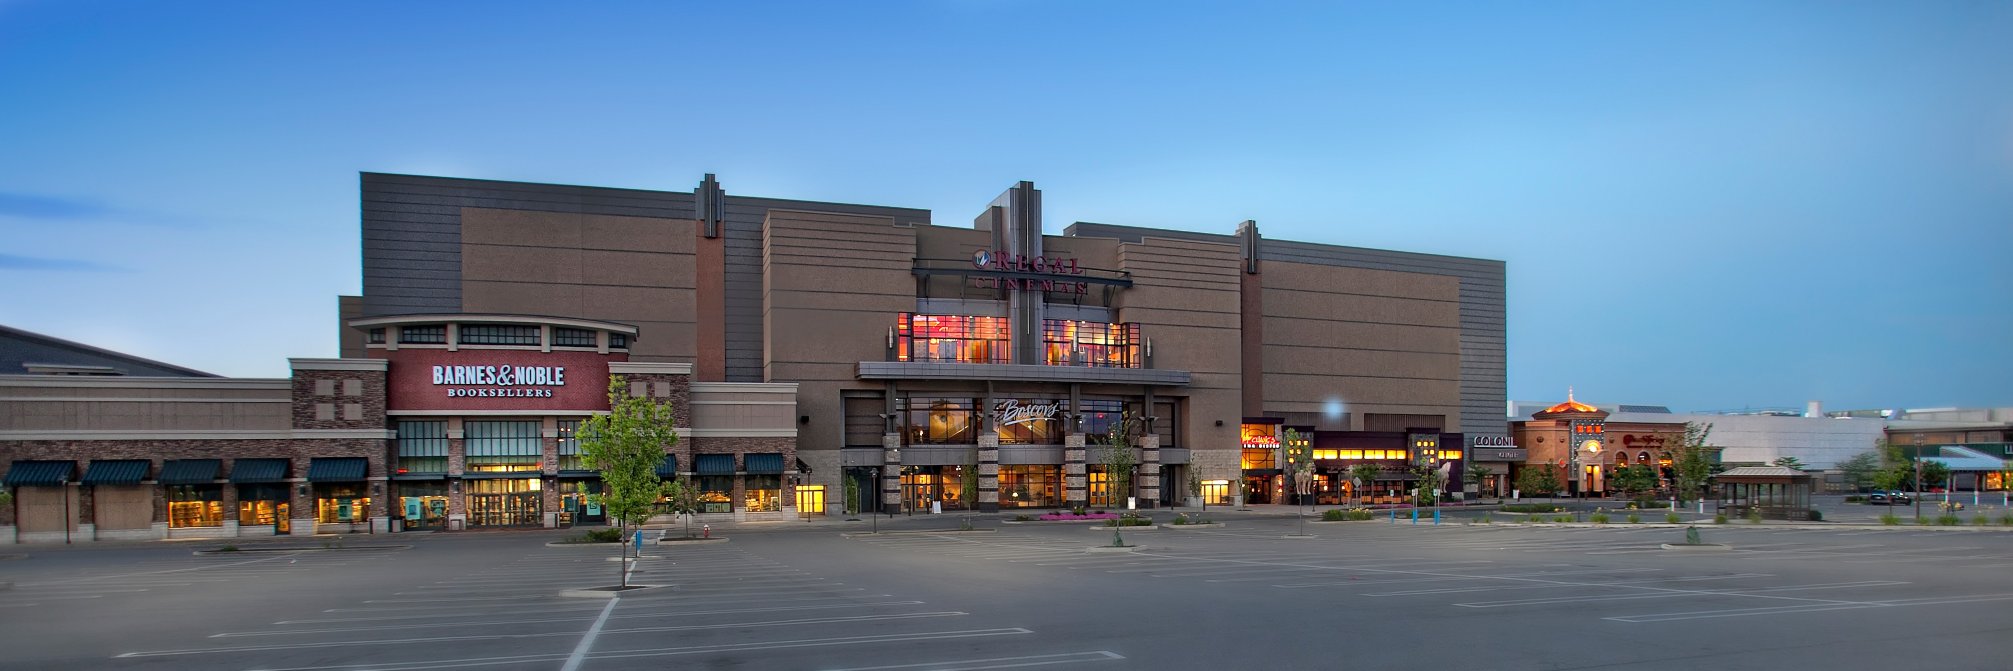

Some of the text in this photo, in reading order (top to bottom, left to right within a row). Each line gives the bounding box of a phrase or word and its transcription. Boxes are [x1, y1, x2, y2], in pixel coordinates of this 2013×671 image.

[994, 250, 1083, 274] REGAL
[975, 277, 1086, 294] CINEMAS
[447, 388, 552, 398] BOOKSELLERS
